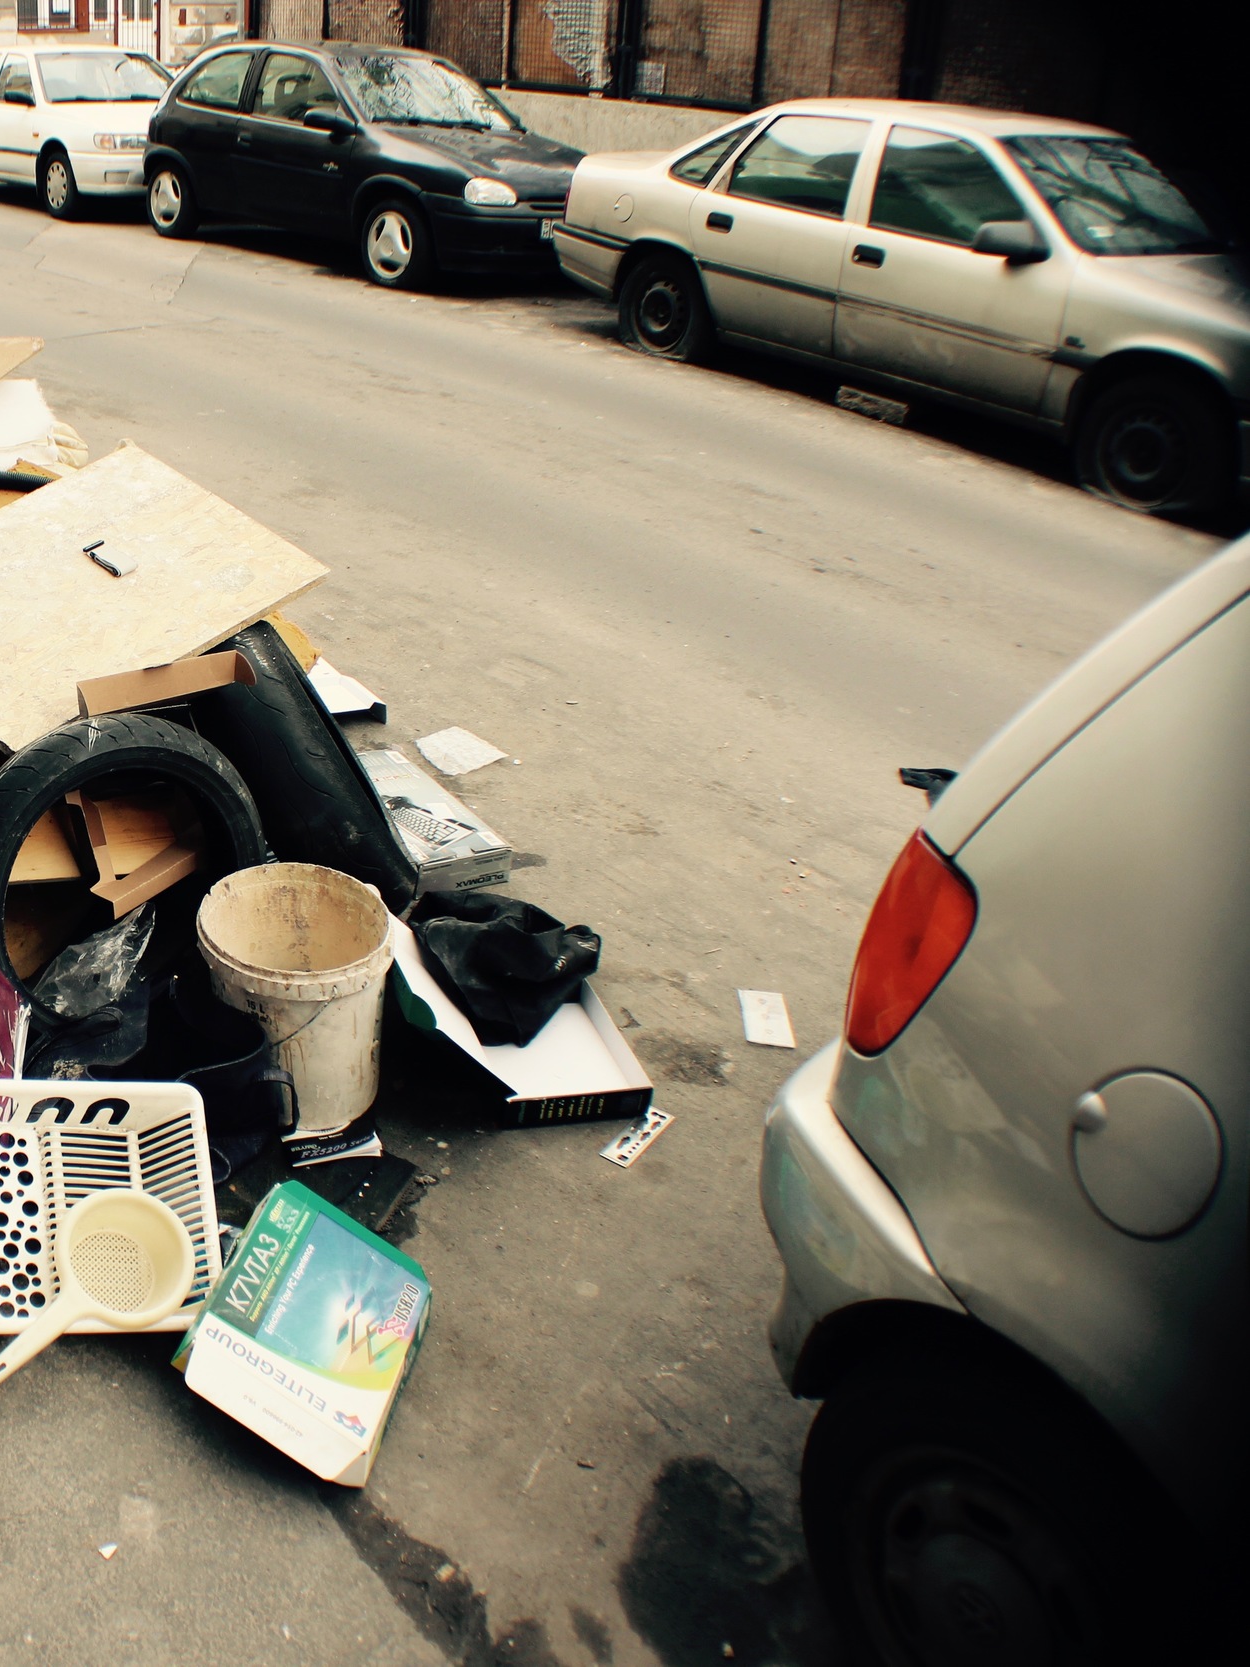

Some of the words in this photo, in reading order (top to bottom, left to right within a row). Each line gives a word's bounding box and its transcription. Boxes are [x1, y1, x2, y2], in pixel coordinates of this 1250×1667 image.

[455, 873, 504, 888] PLEOMAX
[247, 999, 256, 1010] 15
[301, 1142, 347, 1159] FX5200
[225, 1233, 281, 1313] K7VTA3
[264, 1303, 286, 1334] Enriching
[279, 1287, 292, 1304] Your
[286, 1277, 297, 1289] PC
[292, 1243, 315, 1280] Experience
[394, 1283, 419, 1321] USB2.0
[205, 1326, 327, 1412] ELITEGROUP
